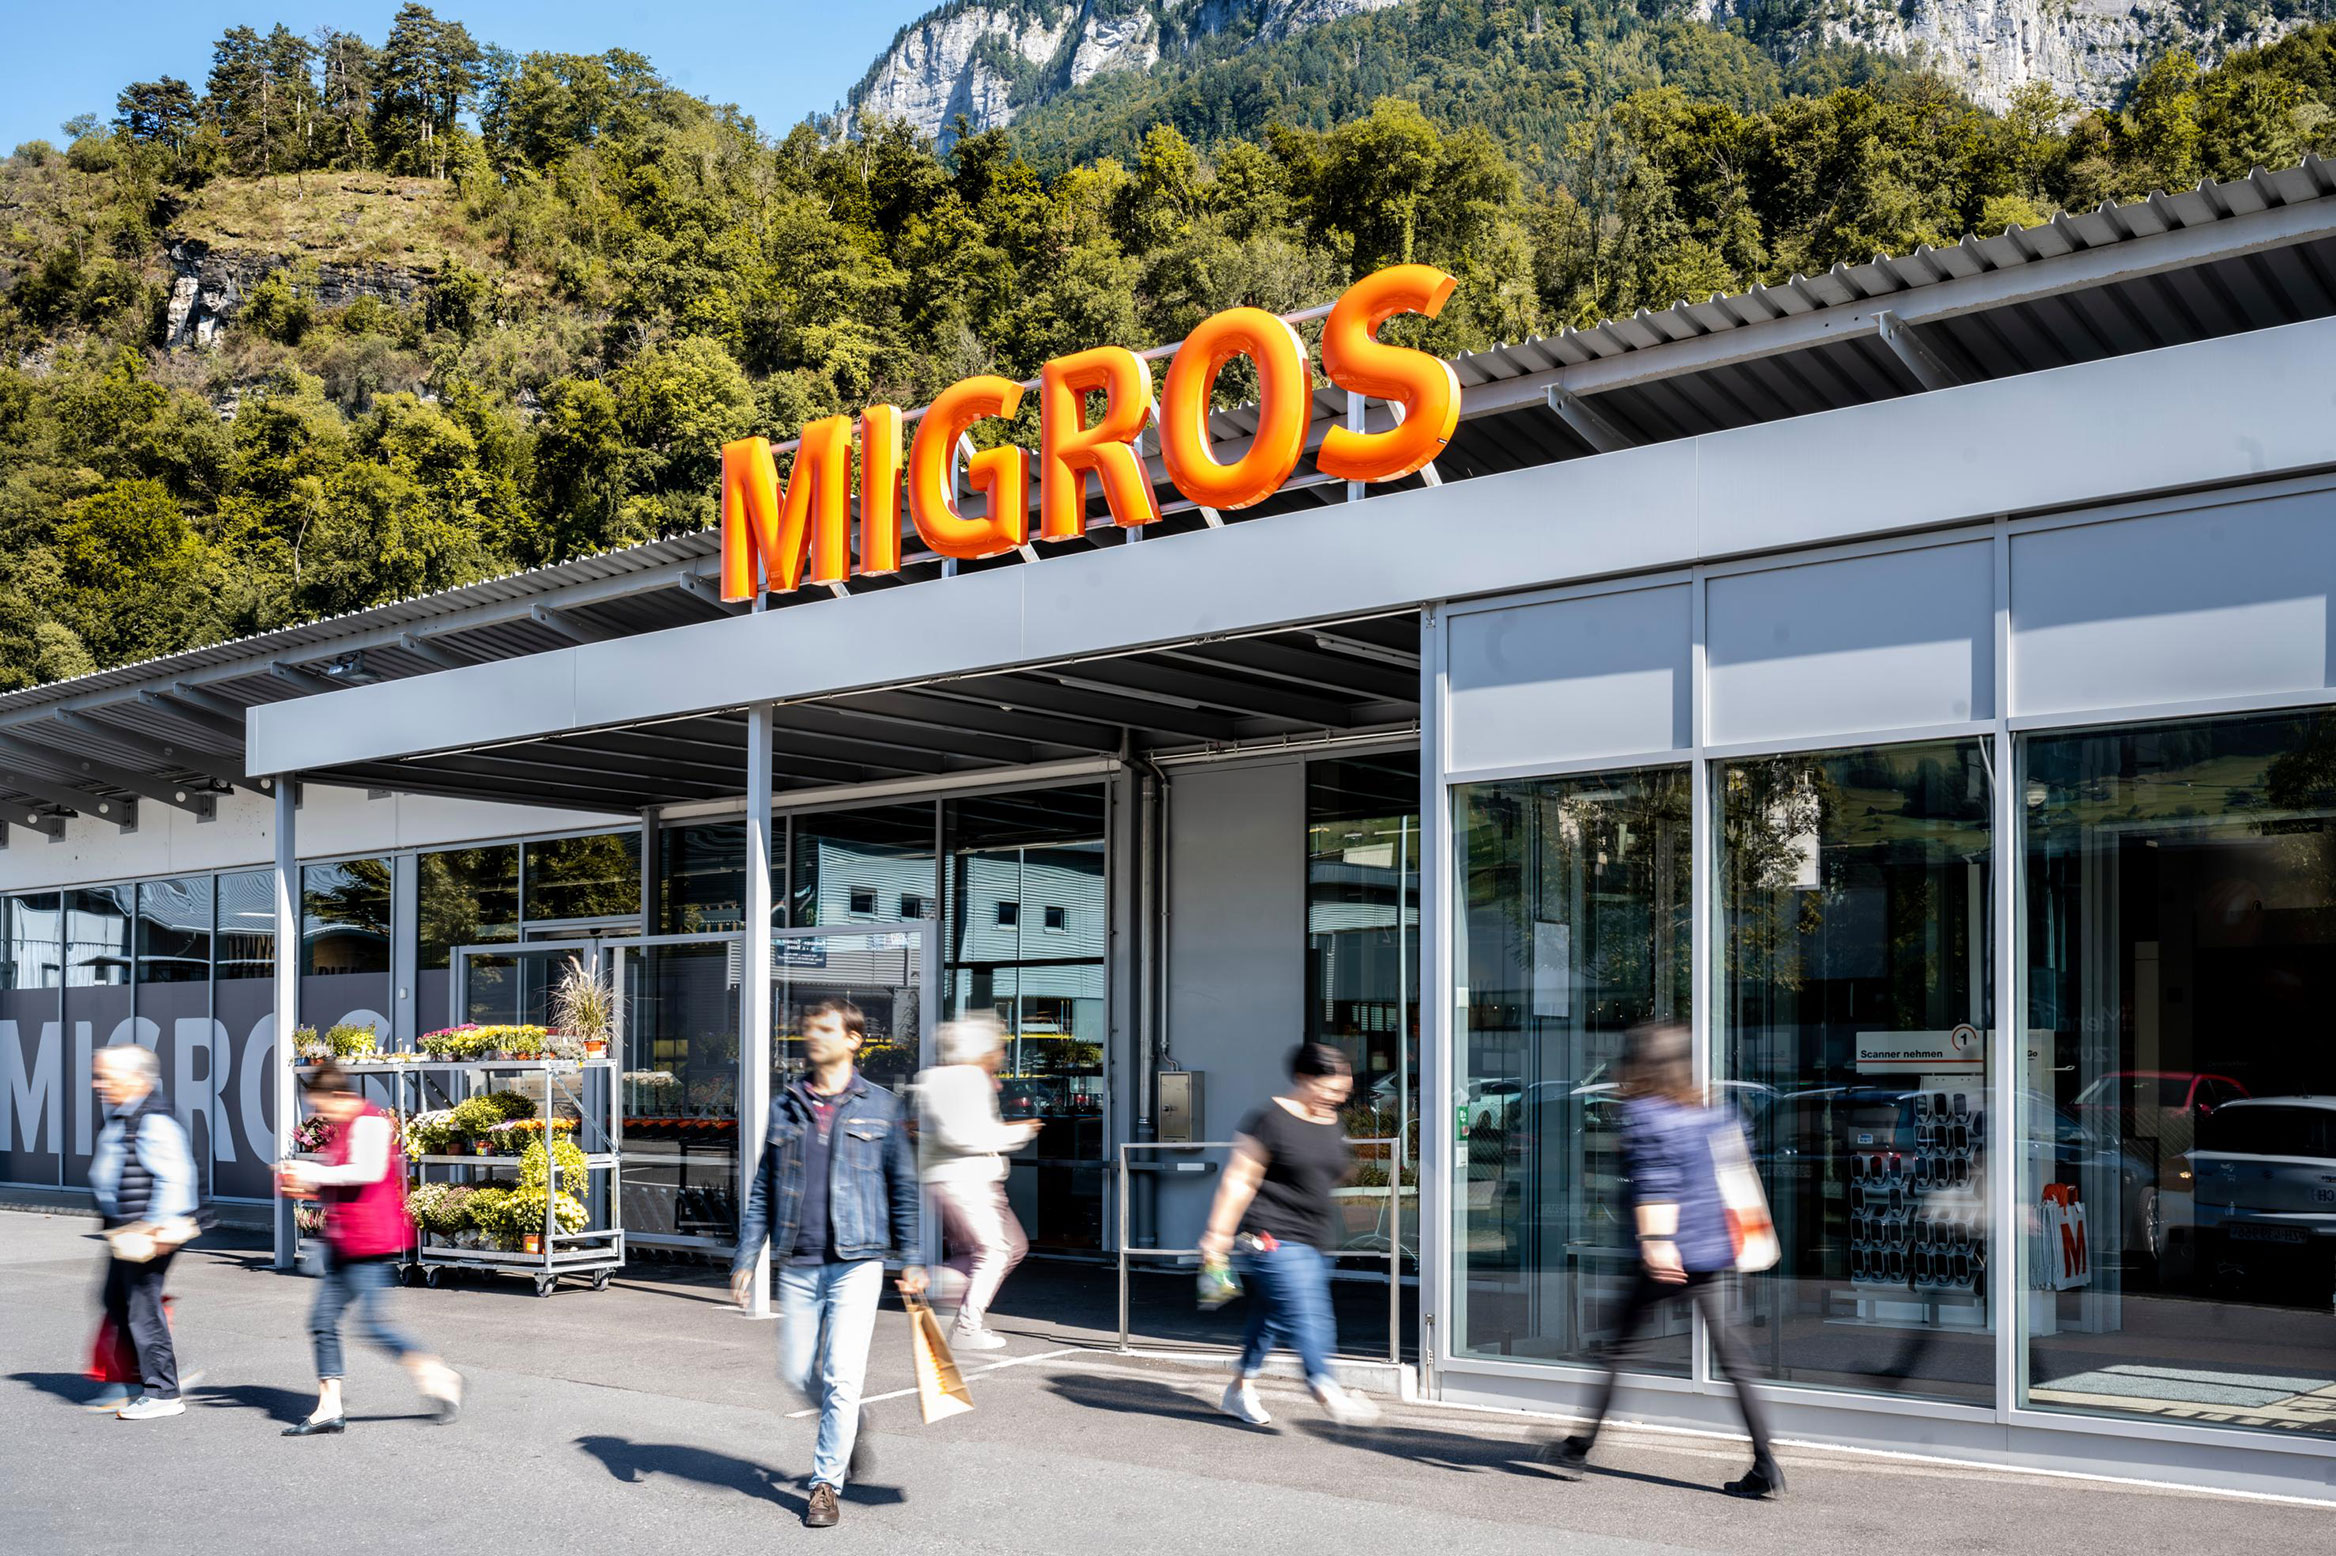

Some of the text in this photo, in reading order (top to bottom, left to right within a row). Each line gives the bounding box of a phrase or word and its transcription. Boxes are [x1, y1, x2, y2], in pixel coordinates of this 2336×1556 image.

[720, 263, 1462, 603] MIGROS
[1860, 1049, 1943, 1060] Scanner nehmen
[1960, 1033, 1968, 1046] 1
[2060, 1219, 2087, 1278] M
